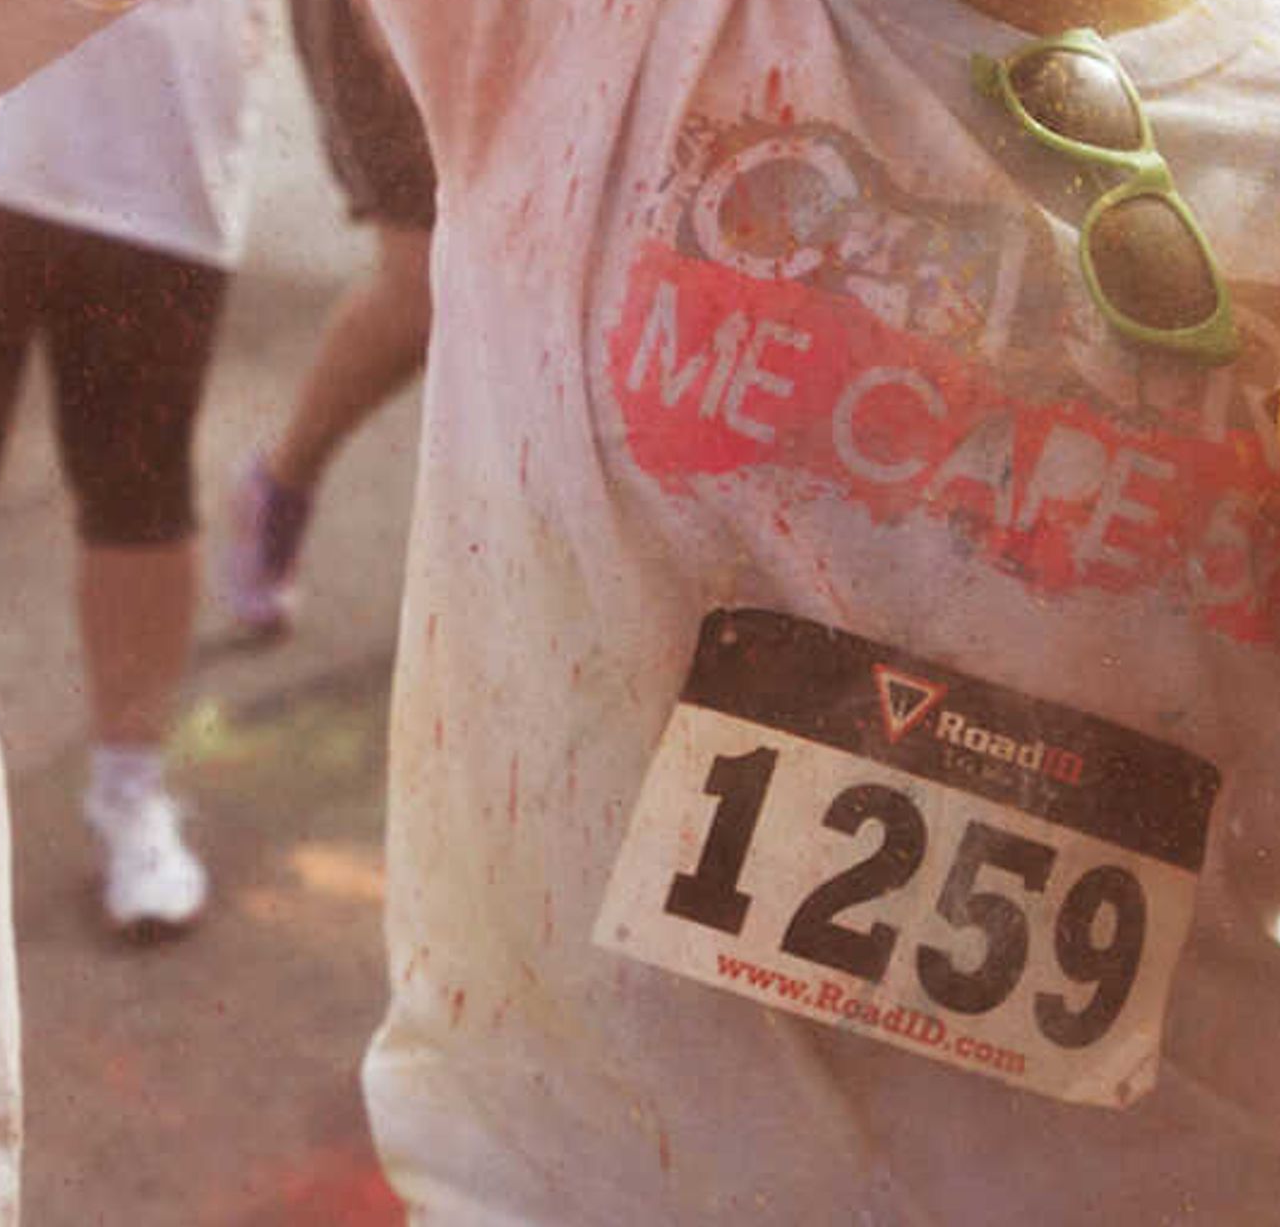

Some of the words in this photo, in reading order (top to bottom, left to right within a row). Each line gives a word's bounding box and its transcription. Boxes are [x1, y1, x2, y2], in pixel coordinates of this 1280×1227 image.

[624, 280, 812, 444] ME
[831, 364, 1178, 570] CAPE
[663, 745, 1148, 1050] 1259
[717, 954, 1026, 1073] www.RoadID.com
